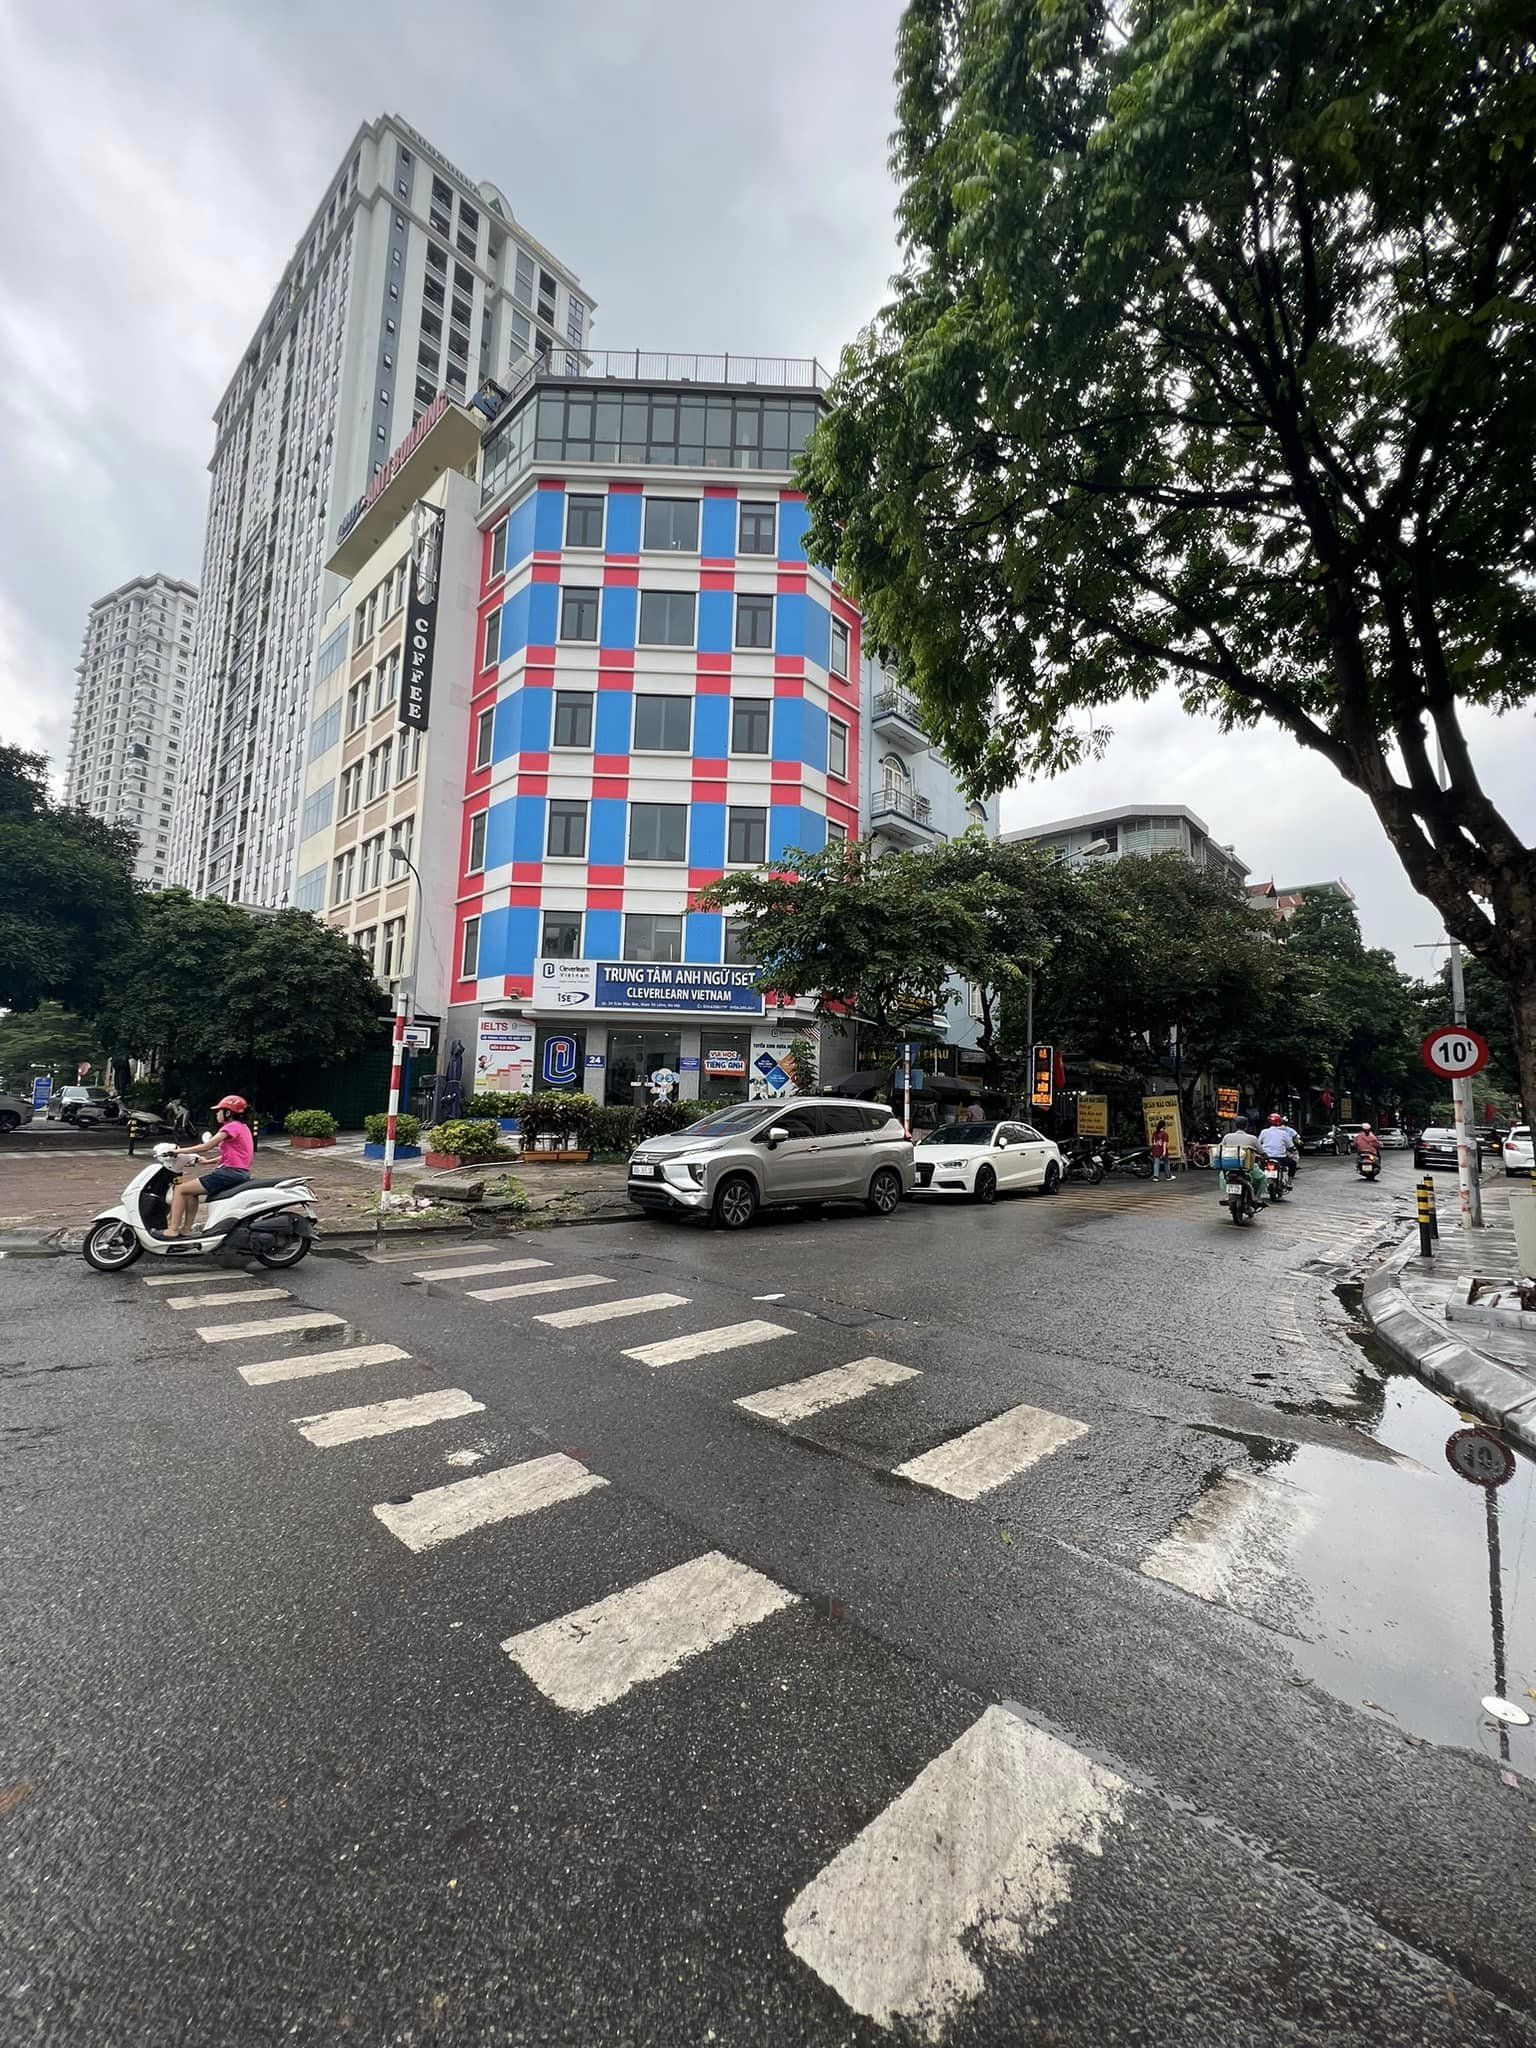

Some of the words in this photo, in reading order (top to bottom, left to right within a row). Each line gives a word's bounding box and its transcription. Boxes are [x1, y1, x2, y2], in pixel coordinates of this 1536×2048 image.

[408, 618, 429, 719] COFFEE
[559, 965, 590, 973] Cleverlearn
[604, 967, 644, 983] TRUNG
[646, 966, 672, 984] TÂM
[675, 970, 701, 984] ANH
[703, 968, 731, 985] NGỮ
[731, 972, 755, 986] ISET
[626, 987, 689, 1000] CLEVERLEARN
[691, 990, 732, 1001] VIETNAM
[480, 1022, 508, 1031] IELTS
[589, 1056, 601, 1064] 24
[705, 1059, 725, 1069] TIẾNG
[726, 1060, 744, 1069] ANH
